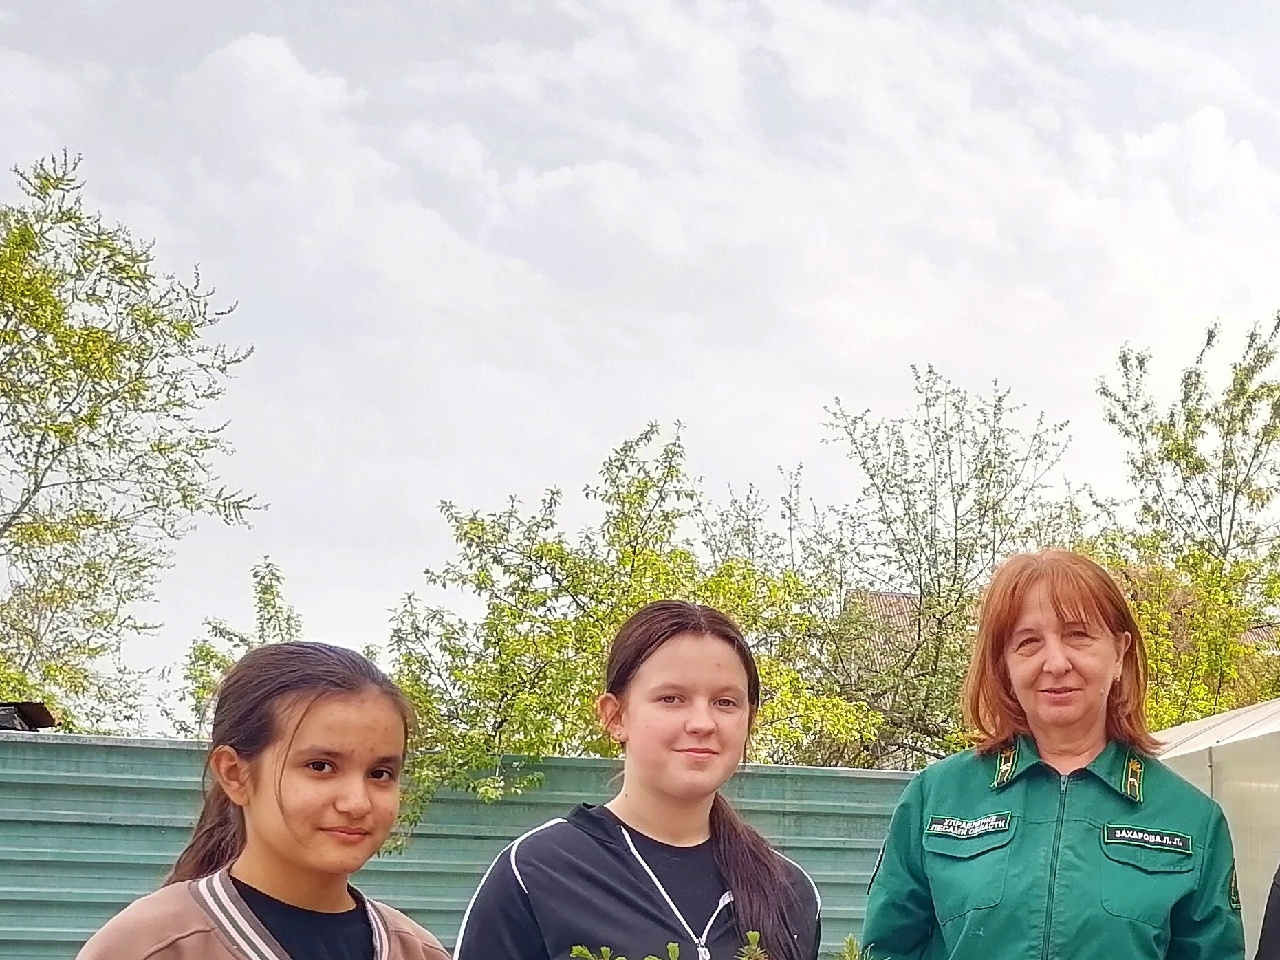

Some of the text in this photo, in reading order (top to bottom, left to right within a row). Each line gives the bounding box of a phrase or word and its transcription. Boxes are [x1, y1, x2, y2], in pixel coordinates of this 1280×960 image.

[931, 820, 1005, 835] ЛЕСАМИ ОБЛАСТИ
[944, 816, 997, 829] УПРАВЛЕНИЕ
[1115, 830, 1162, 842] ЗАХАРОВА
